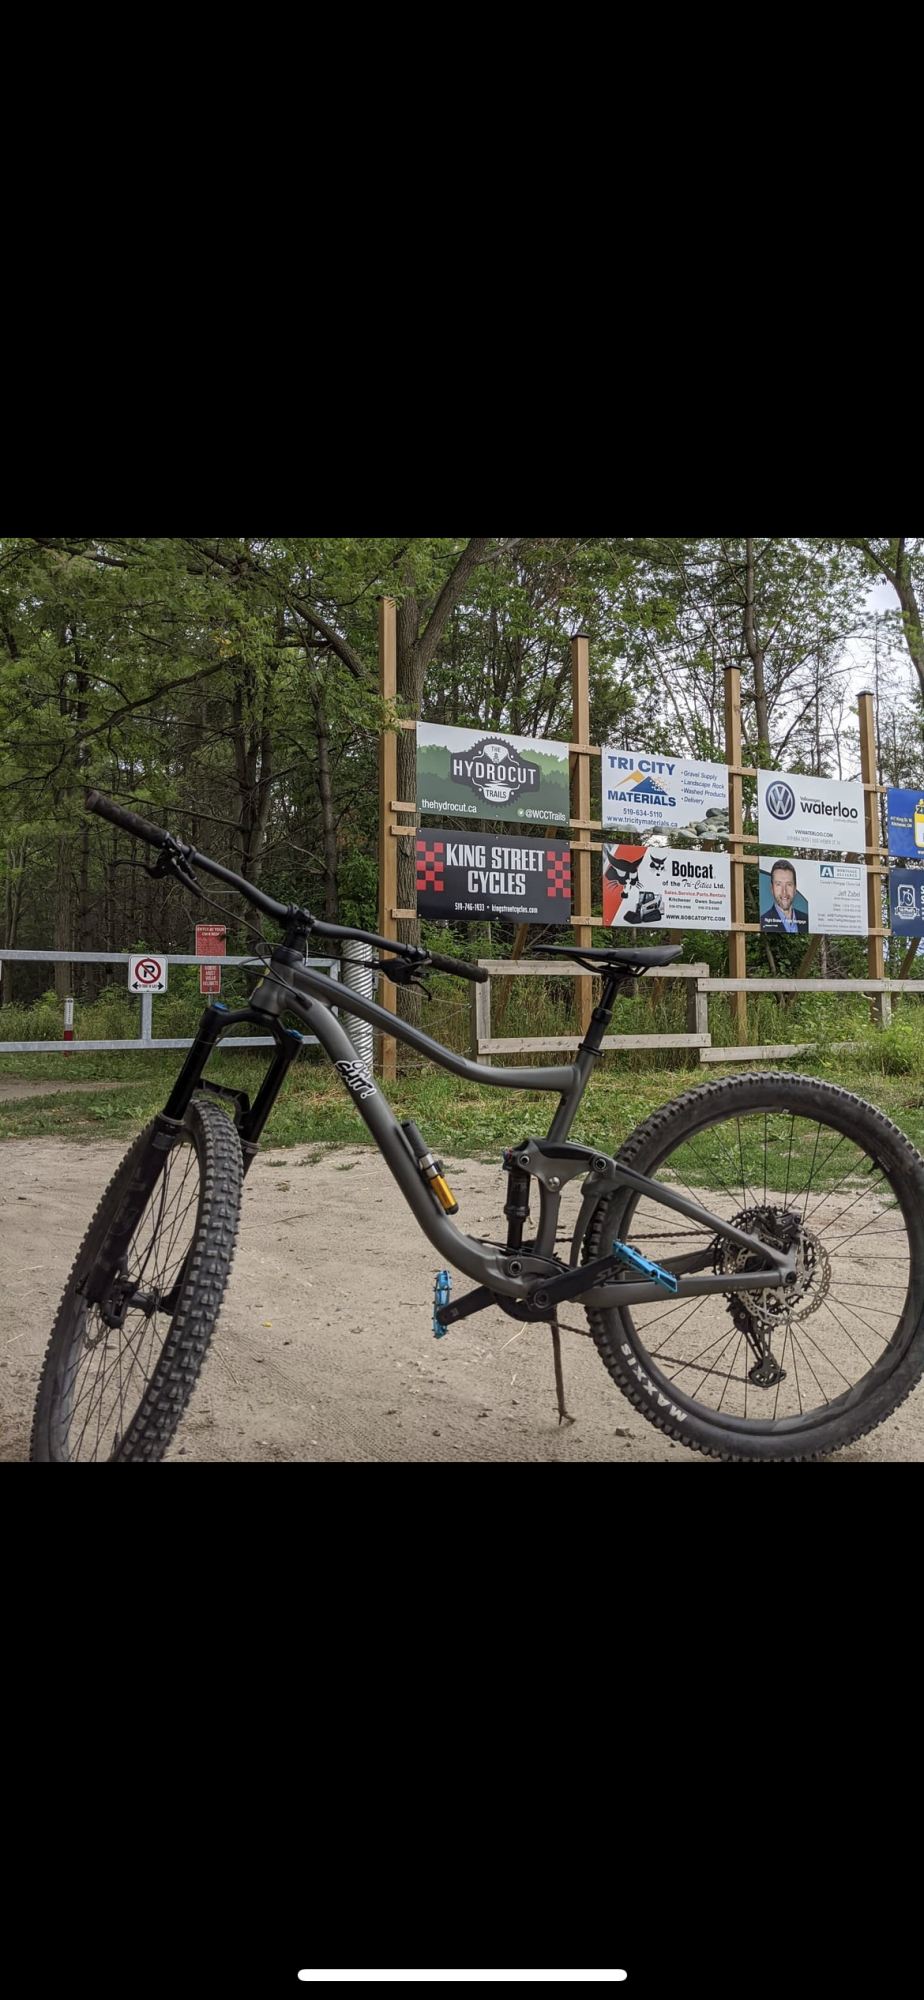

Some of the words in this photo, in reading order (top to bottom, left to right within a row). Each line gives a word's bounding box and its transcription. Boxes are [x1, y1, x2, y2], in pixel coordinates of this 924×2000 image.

[453, 759, 537, 785] HYDROCUT
[608, 755, 634, 771] TRI
[637, 759, 676, 776] CITY
[683, 770, 700, 778] Gravel
[700, 773, 718, 781] Supply
[683, 780, 711, 788] Landscape
[711, 782, 725, 790] Rock
[486, 789, 507, 799] TRAILS
[607, 790, 677, 807] MATERIALS
[683, 788, 704, 796] Washed
[704, 790, 727, 798] Products
[421, 799, 478, 814] thehydrocut.ca
[683, 797, 705, 806] Delivery
[525, 808, 567, 822] @WCCTrails
[623, 807, 663, 819] 519-634-5110
[800, 801, 858, 819] waterloo
[606, 815, 678, 828] www.tricitymaterials.ca
[446, 843, 487, 868] KING
[491, 846, 545, 872] STREET
[671, 860, 714, 880] Bobcat
[467, 870, 527, 896] CYCLES
[682, 879, 713, 890] Tri-Cities
[491, 904, 538, 915] kingstreetcycles.com
[666, 914, 726, 922] WWW.BOBCATOFTC.COM
[621, 1343, 688, 1422] MAXXIS
